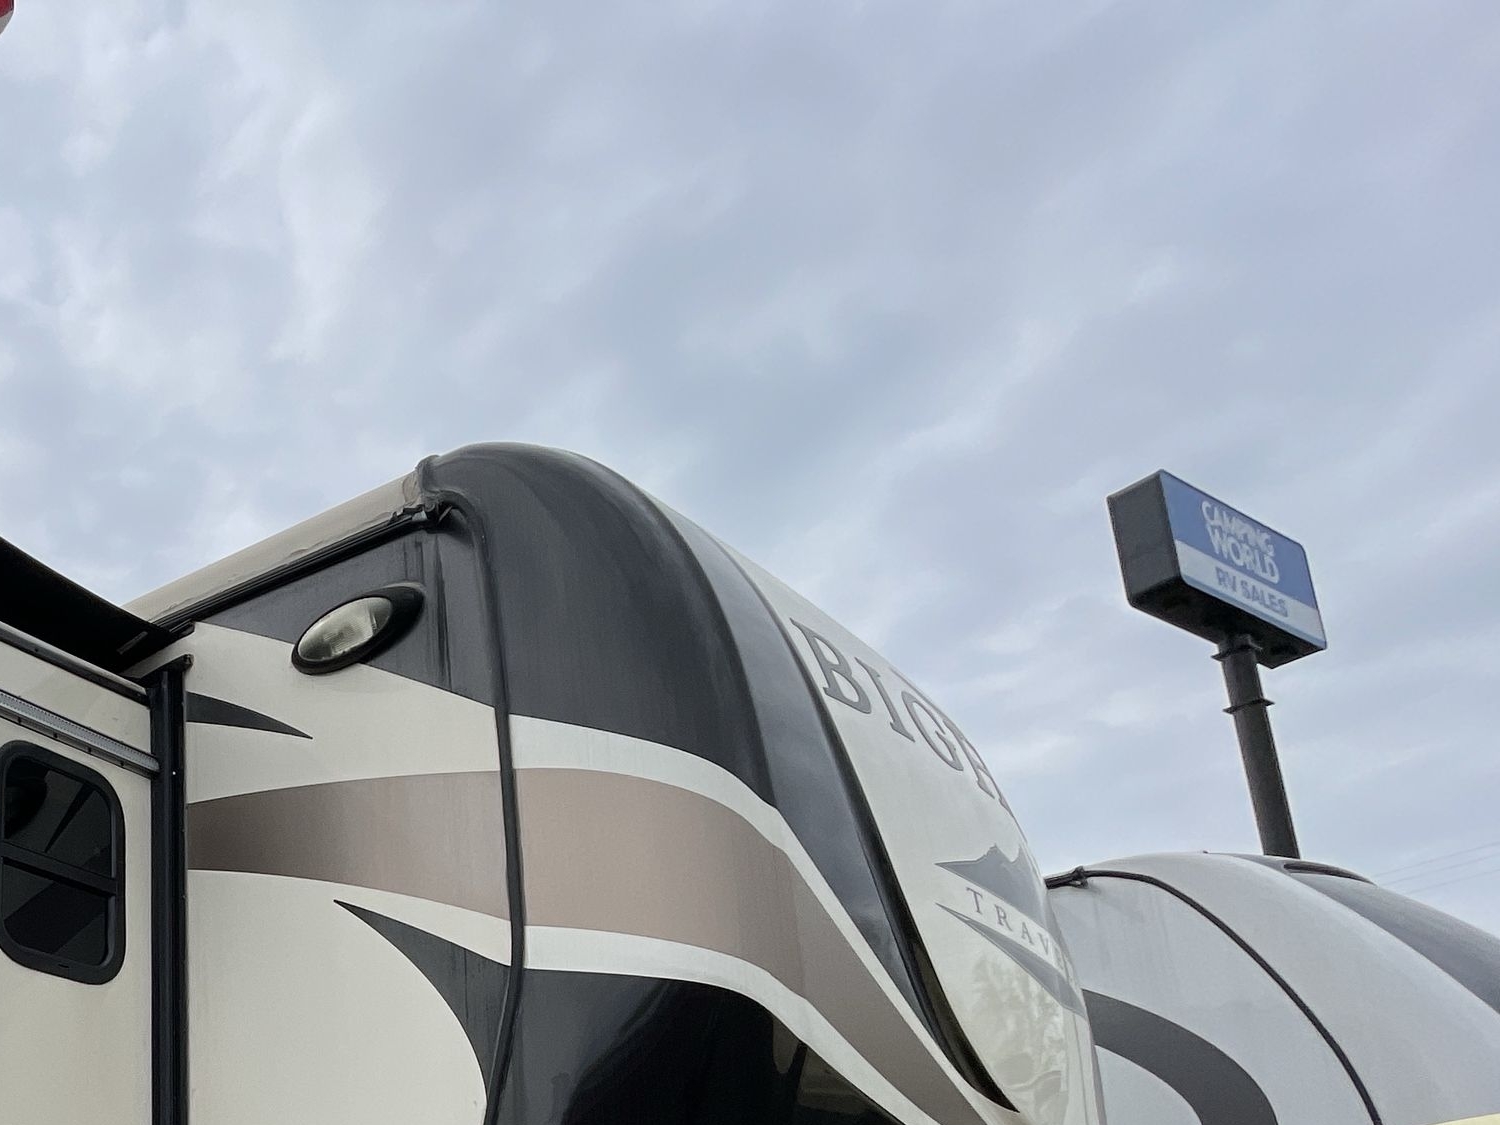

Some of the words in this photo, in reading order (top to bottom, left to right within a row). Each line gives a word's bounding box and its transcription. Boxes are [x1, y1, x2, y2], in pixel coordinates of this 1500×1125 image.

[1202, 501, 1275, 557] CAMPING
[1206, 523, 1279, 584] WORLD
[1215, 566, 1237, 592] RV
[1240, 580, 1288, 617] SALES
